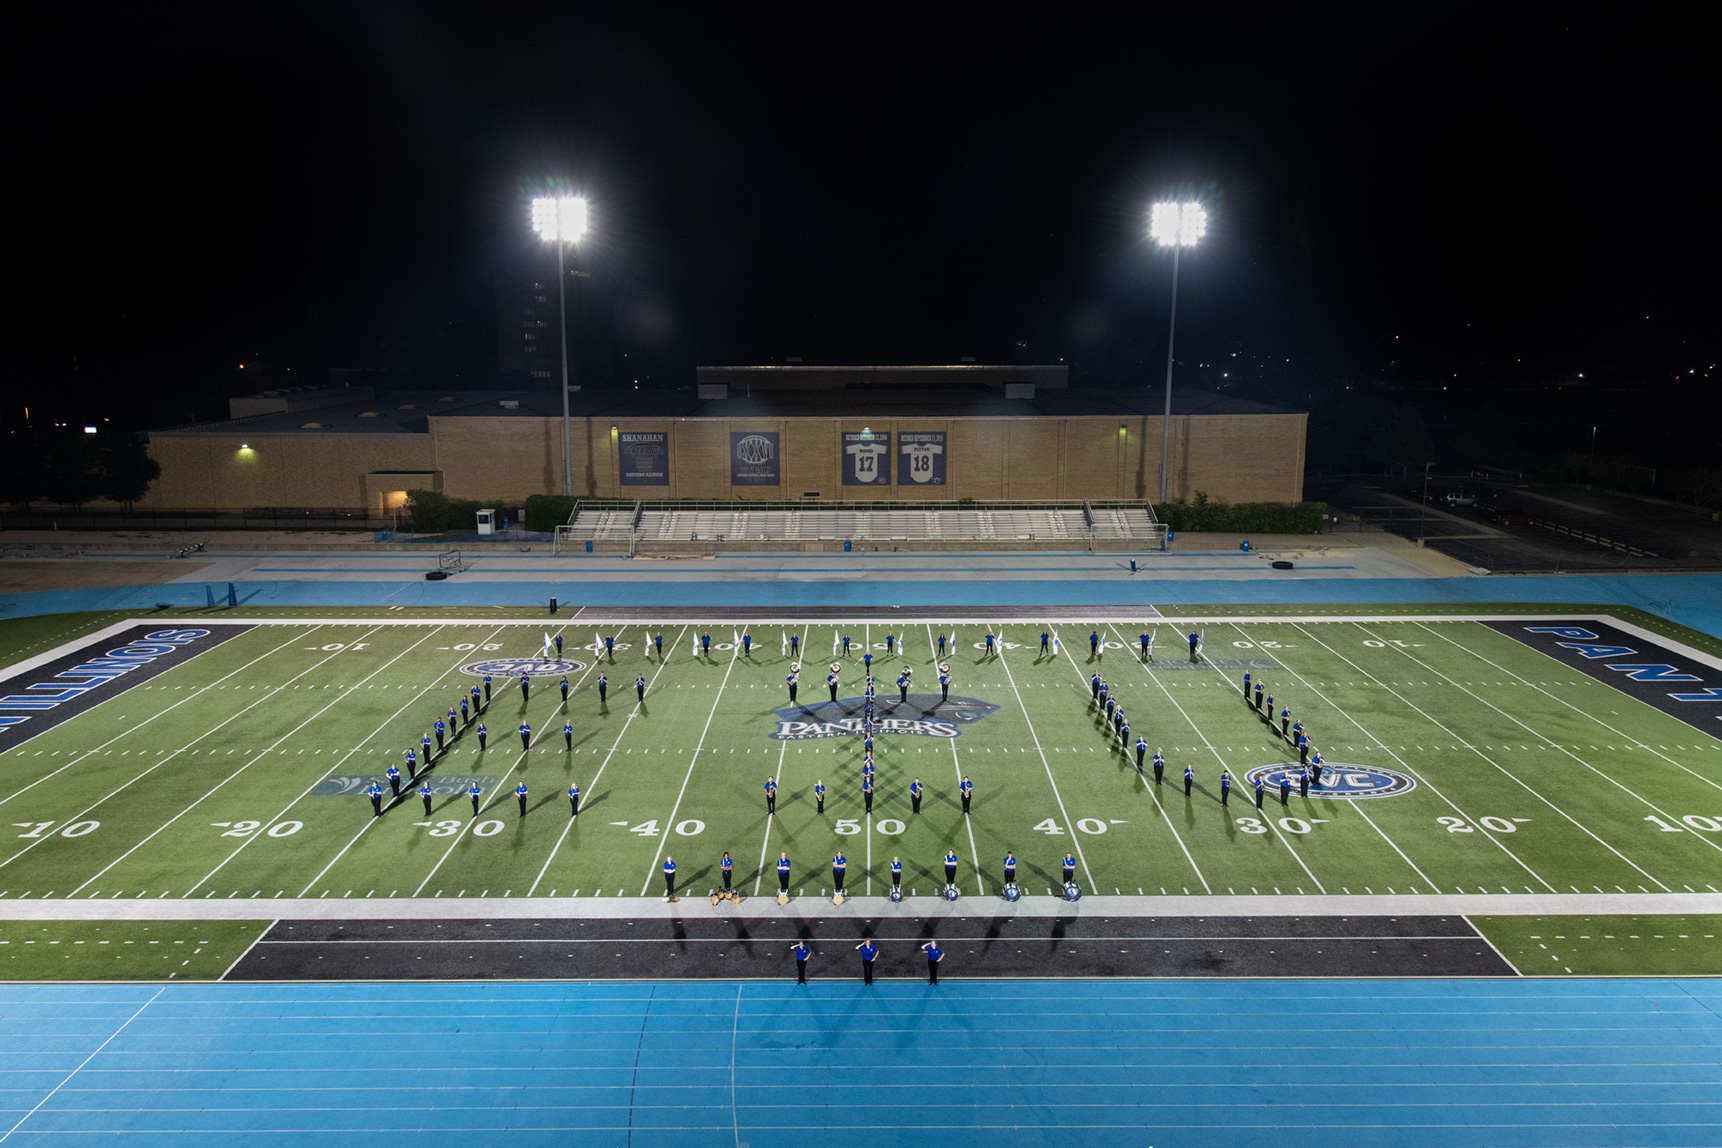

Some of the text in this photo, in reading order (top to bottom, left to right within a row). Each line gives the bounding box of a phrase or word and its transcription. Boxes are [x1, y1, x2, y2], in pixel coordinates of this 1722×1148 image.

[622, 434, 663, 442] SHANAHAN
[858, 456, 874, 472] 17
[914, 455, 930, 472] 18
[0, 628, 211, 710] ILLINOIS
[1523, 626, 1722, 721] PANT
